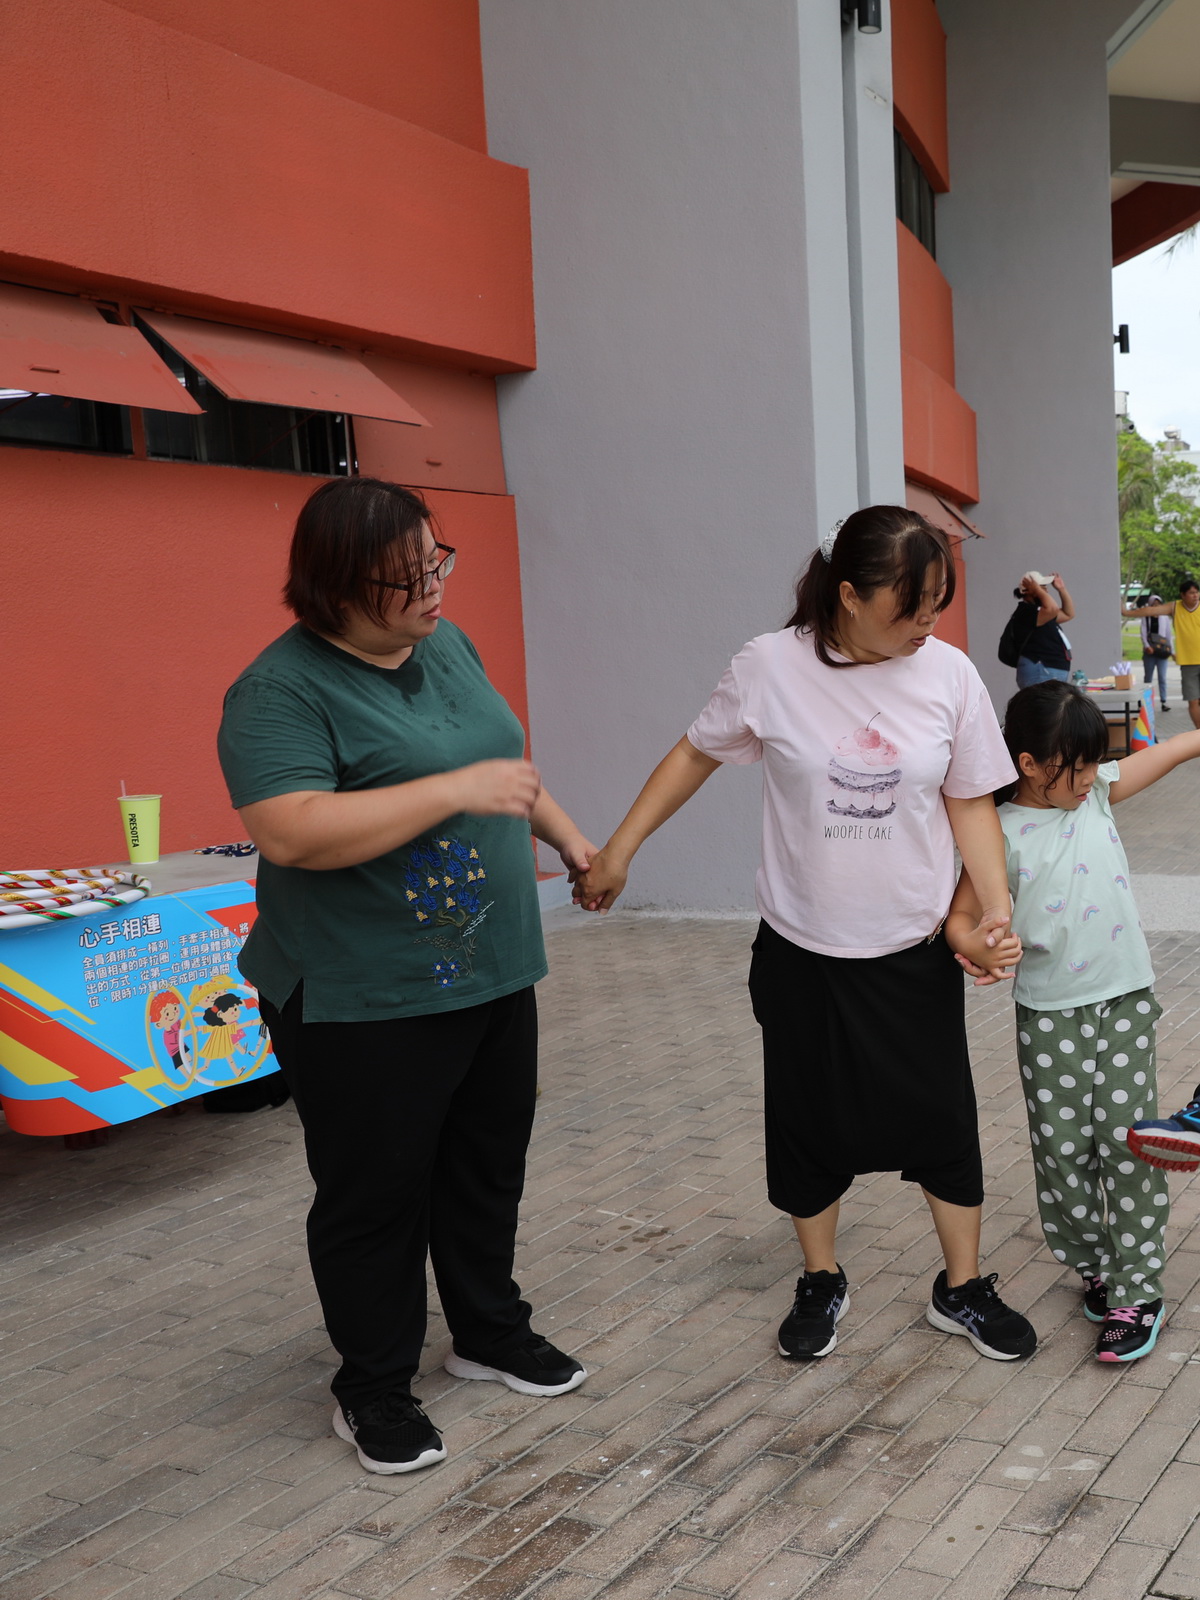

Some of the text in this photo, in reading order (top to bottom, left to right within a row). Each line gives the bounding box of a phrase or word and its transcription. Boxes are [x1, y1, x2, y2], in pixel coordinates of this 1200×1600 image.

[128, 813, 140, 848] PRESOTEA
[824, 825, 893, 841] WOOPIE CAKE
[79, 913, 162, 949] 心手相連
